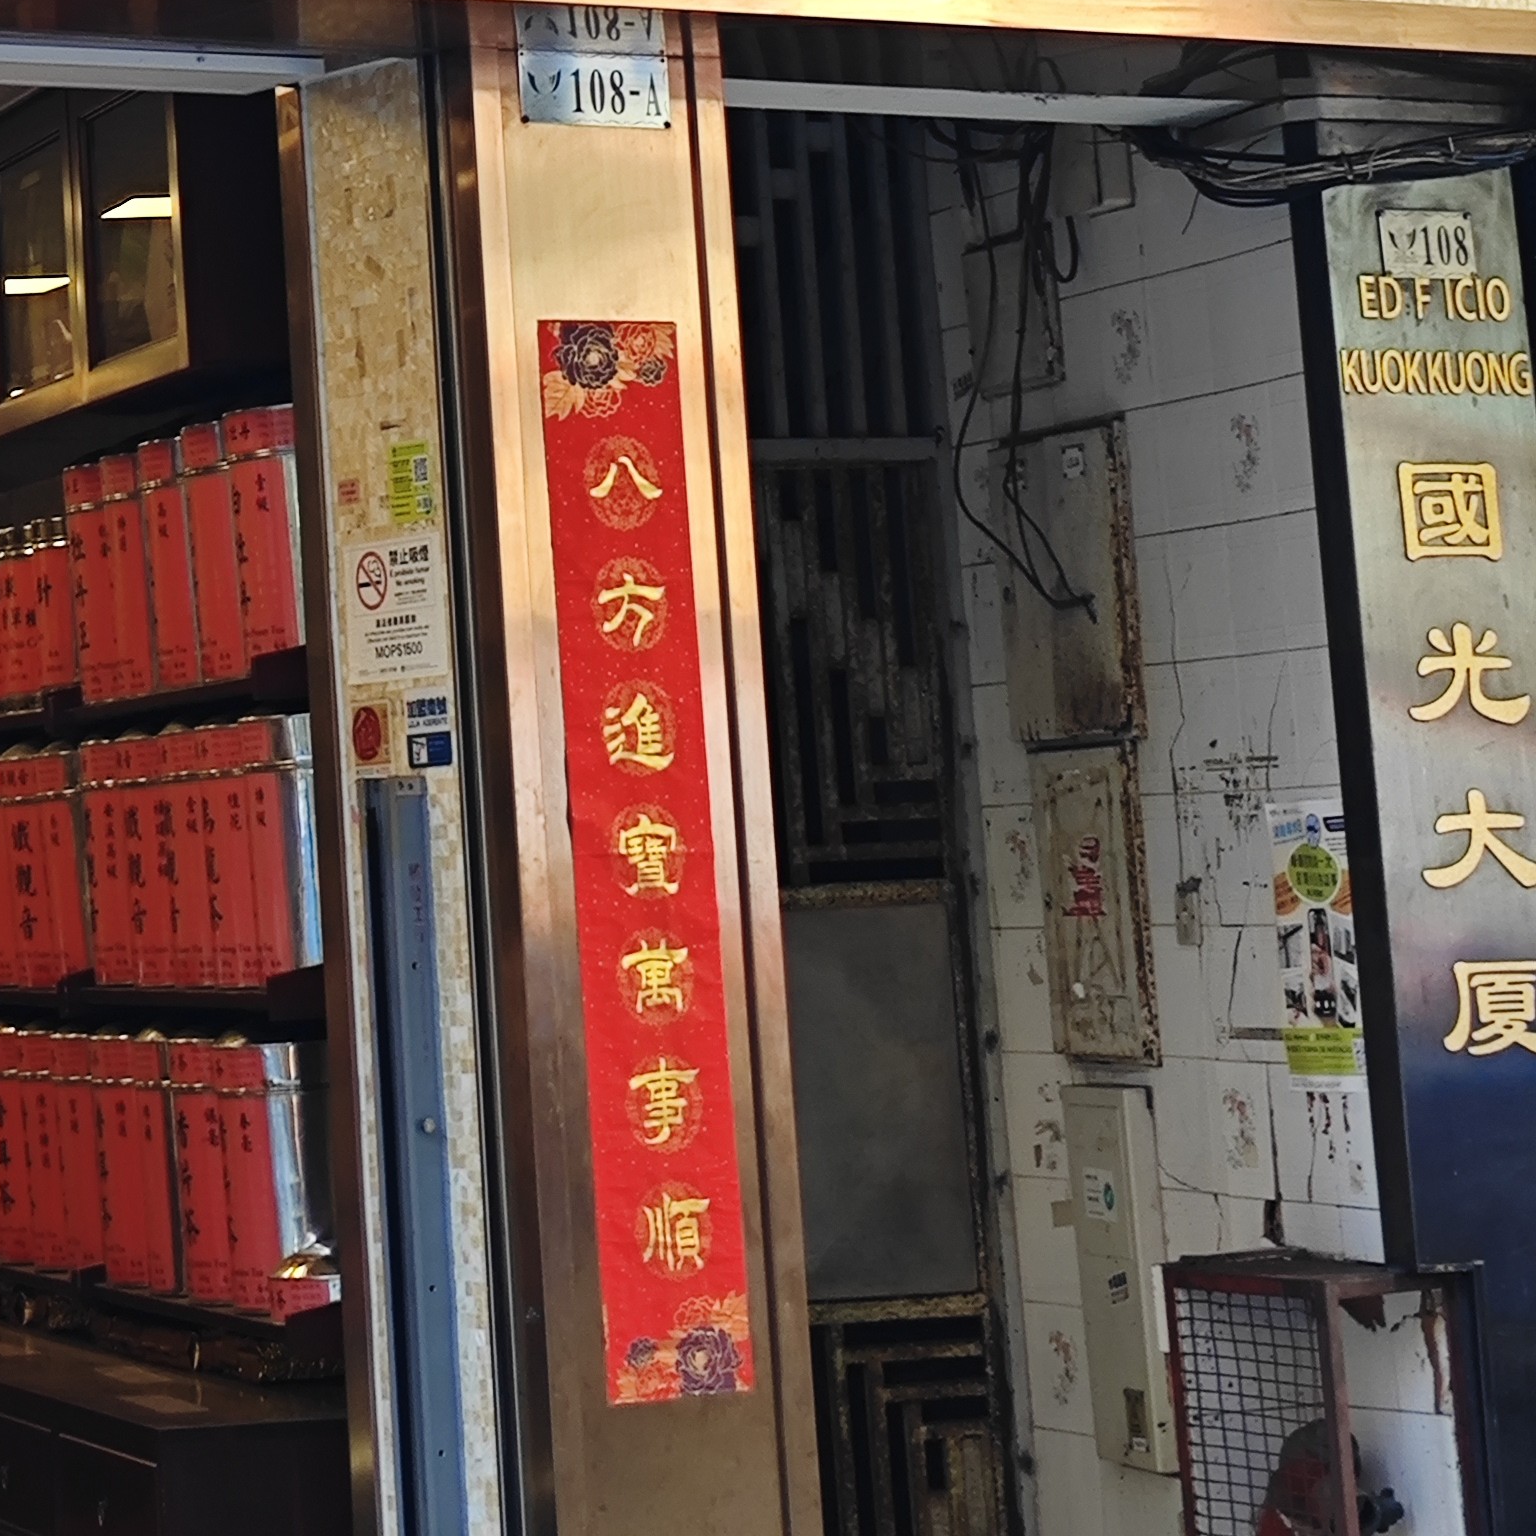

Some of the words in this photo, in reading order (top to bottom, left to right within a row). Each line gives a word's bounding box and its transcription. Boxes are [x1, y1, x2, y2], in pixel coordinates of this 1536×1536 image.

[570, 67, 662, 117] 108-A
[1421, 225, 1468, 266] 108
[586, 454, 710, 1271] 八方進寶萬事順
